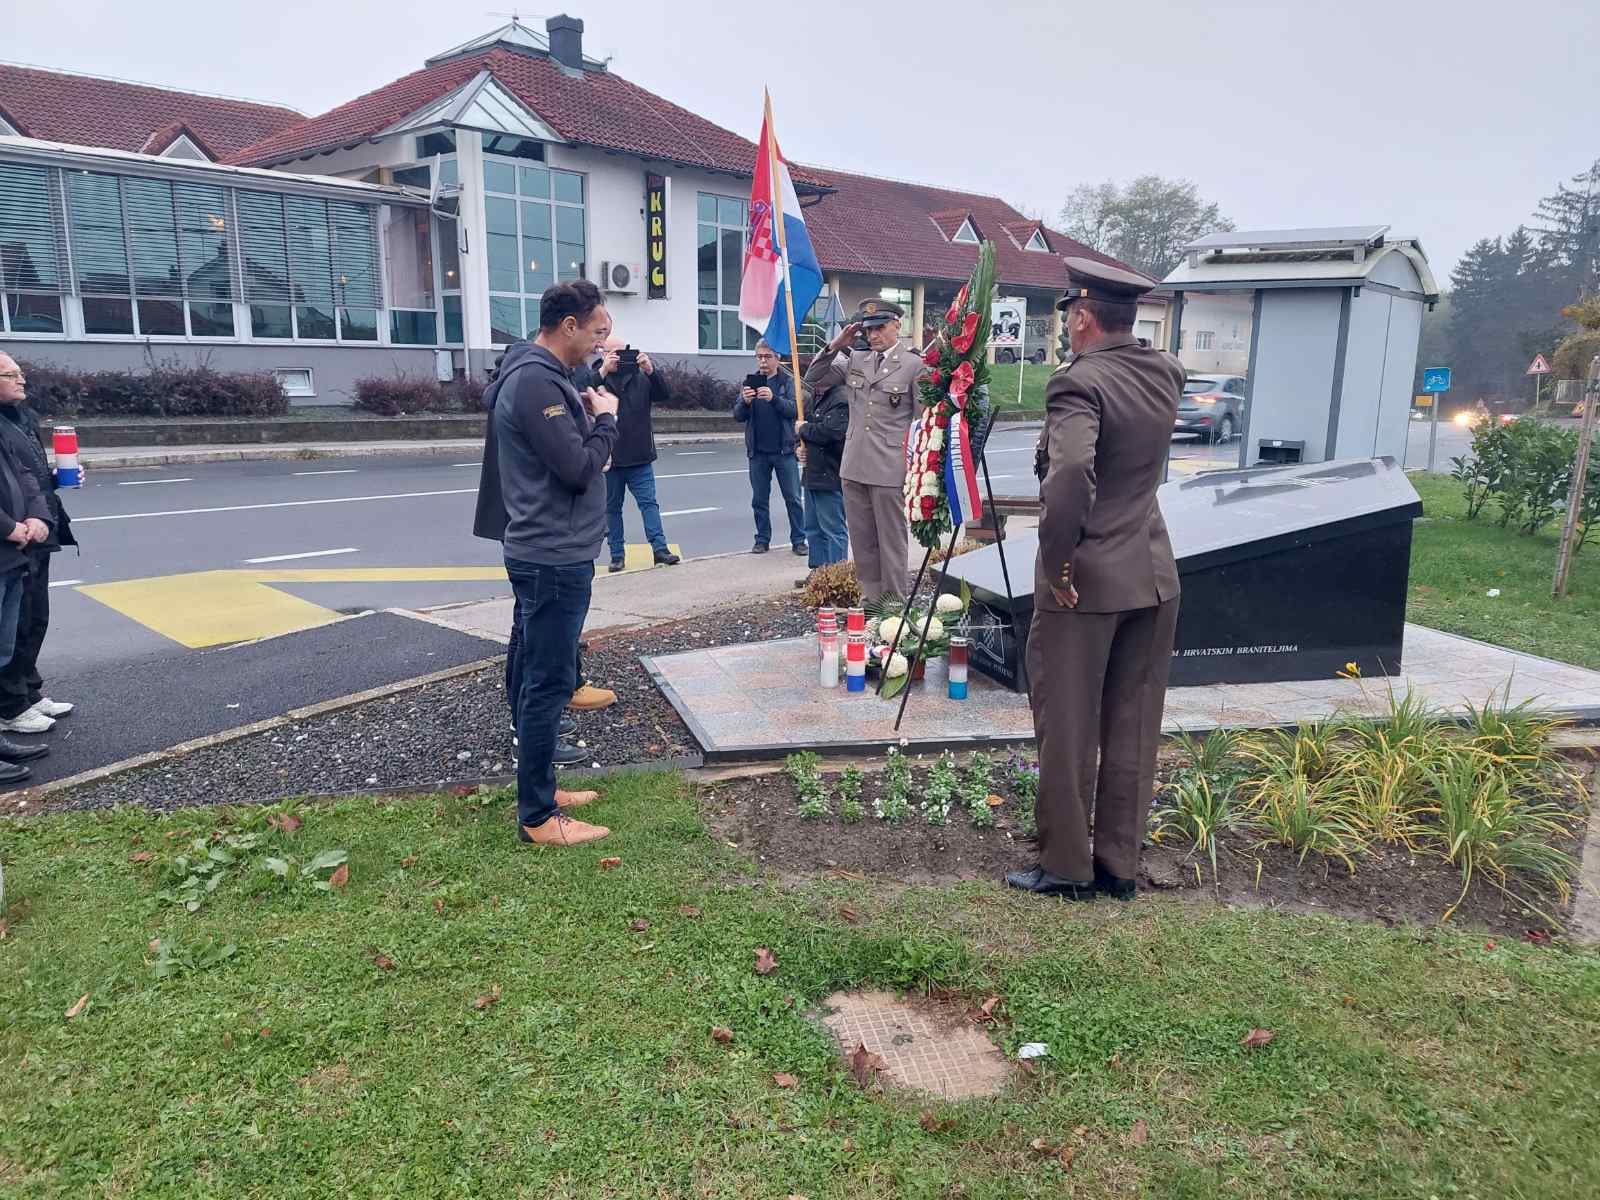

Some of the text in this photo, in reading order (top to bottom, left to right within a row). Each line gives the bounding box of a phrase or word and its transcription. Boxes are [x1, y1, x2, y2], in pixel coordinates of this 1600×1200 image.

[650, 191, 665, 286] KRUG
[1183, 647, 1233, 657] HRVATSKIM
[1236, 645, 1298, 655] BRANITELJIMA
